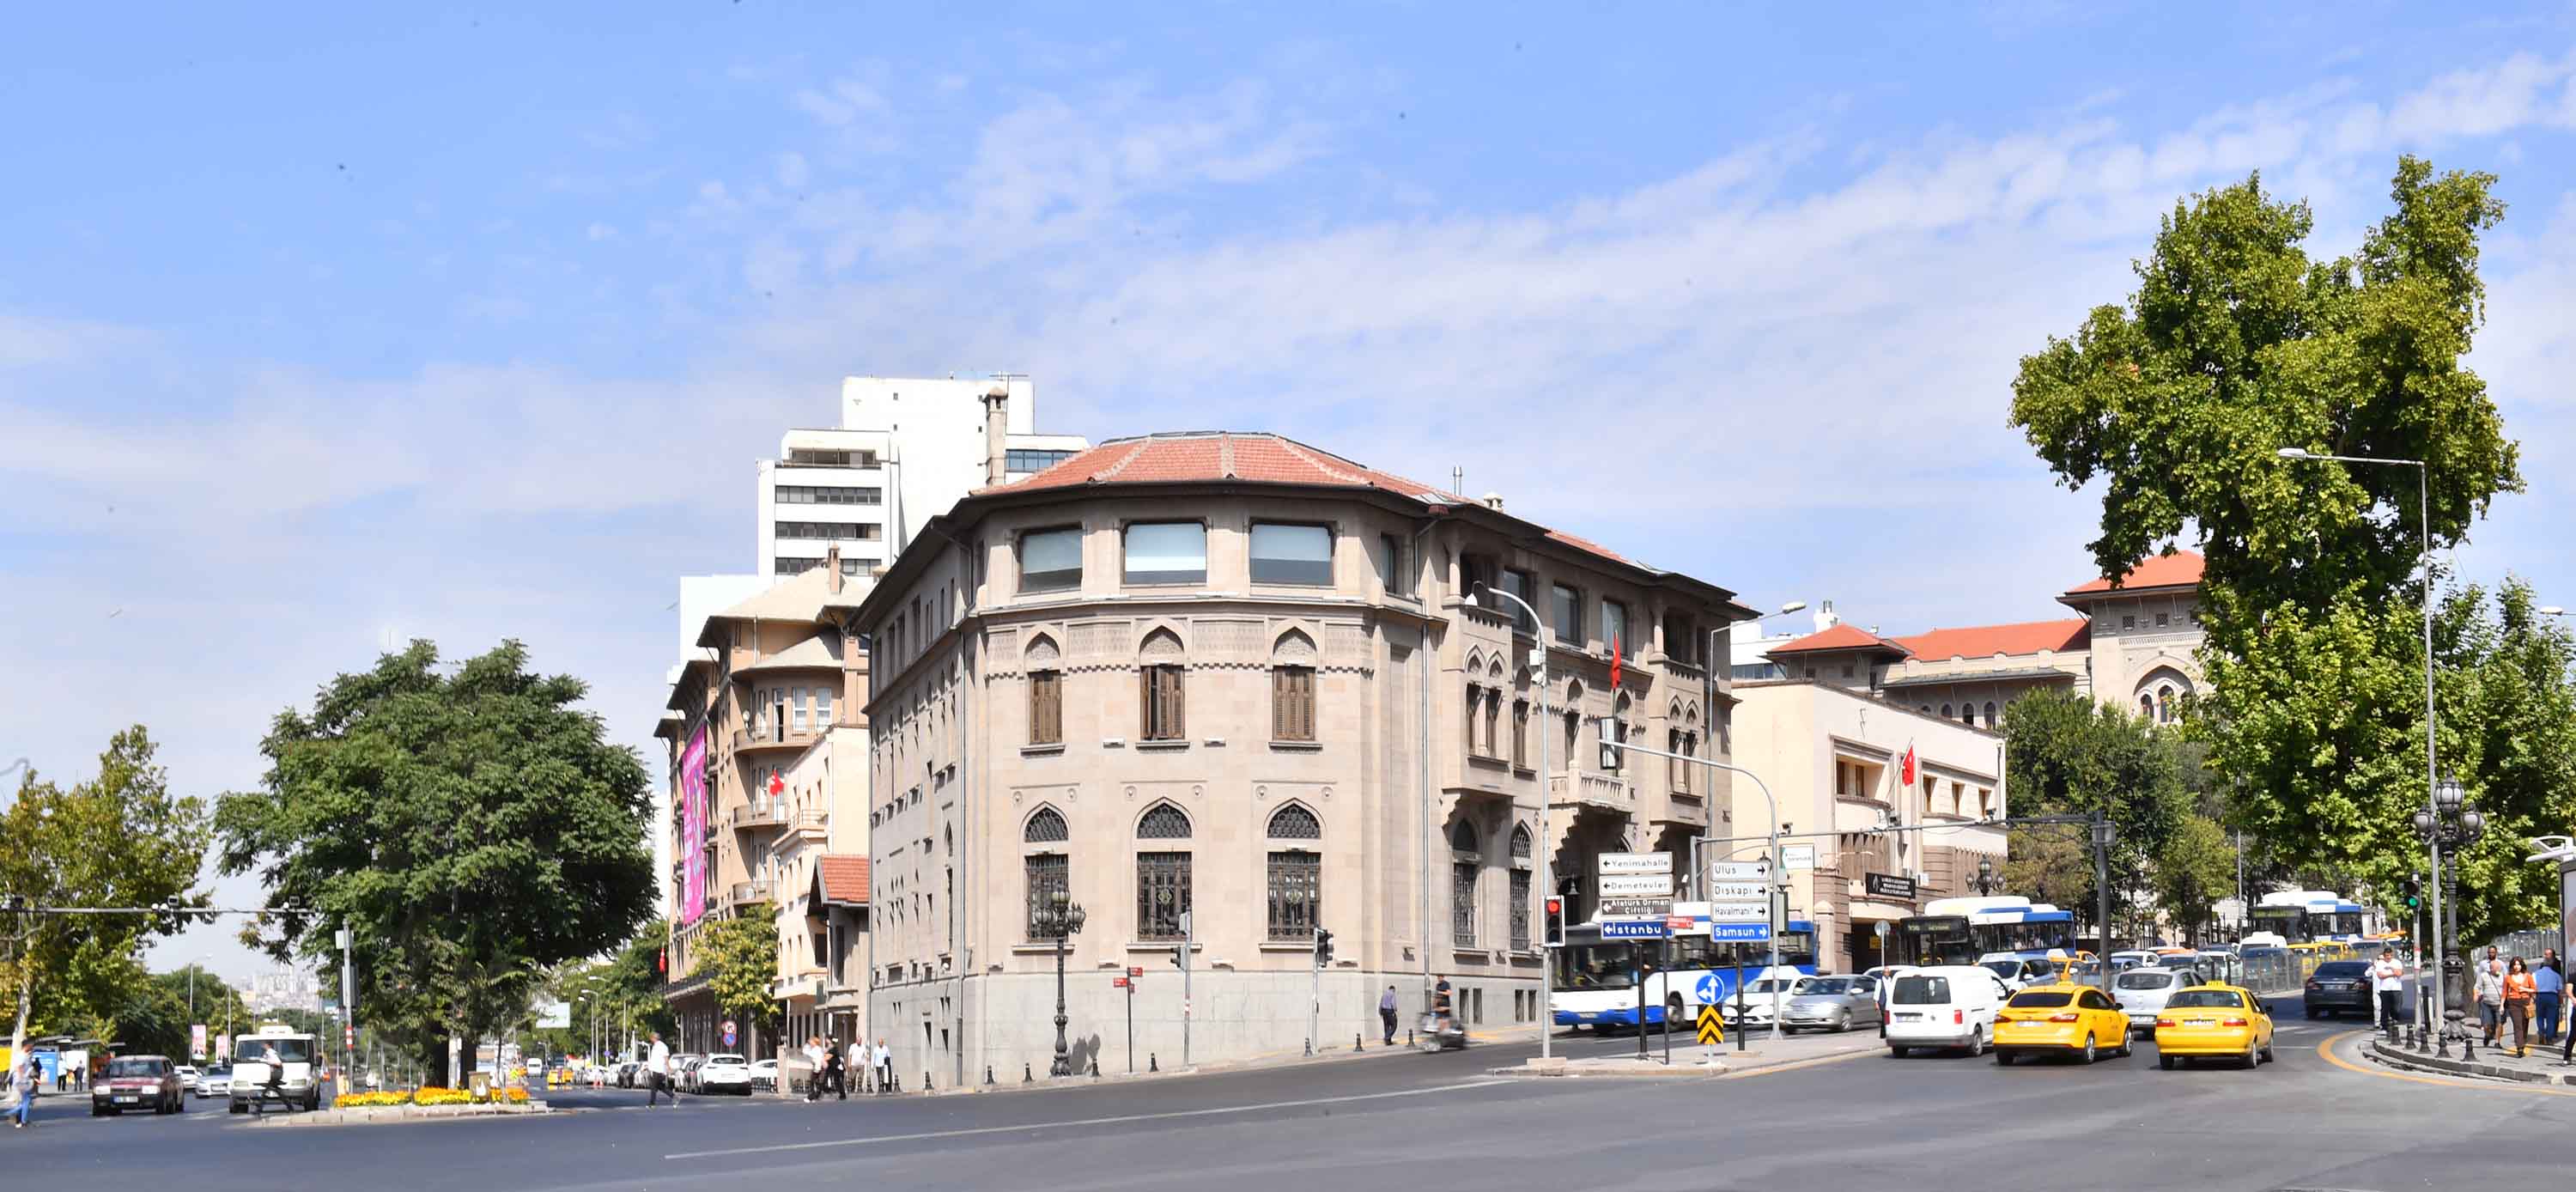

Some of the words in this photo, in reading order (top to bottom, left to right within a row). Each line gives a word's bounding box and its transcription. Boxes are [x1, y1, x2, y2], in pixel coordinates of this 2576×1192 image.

[1612, 859, 1668, 867] Yenimahalle
[1715, 866, 1737, 874] Ulus
[1611, 881, 1668, 890] Demetevler
[1613, 921, 1662, 934] İstanbu
[1716, 927, 1755, 937] Samsun
